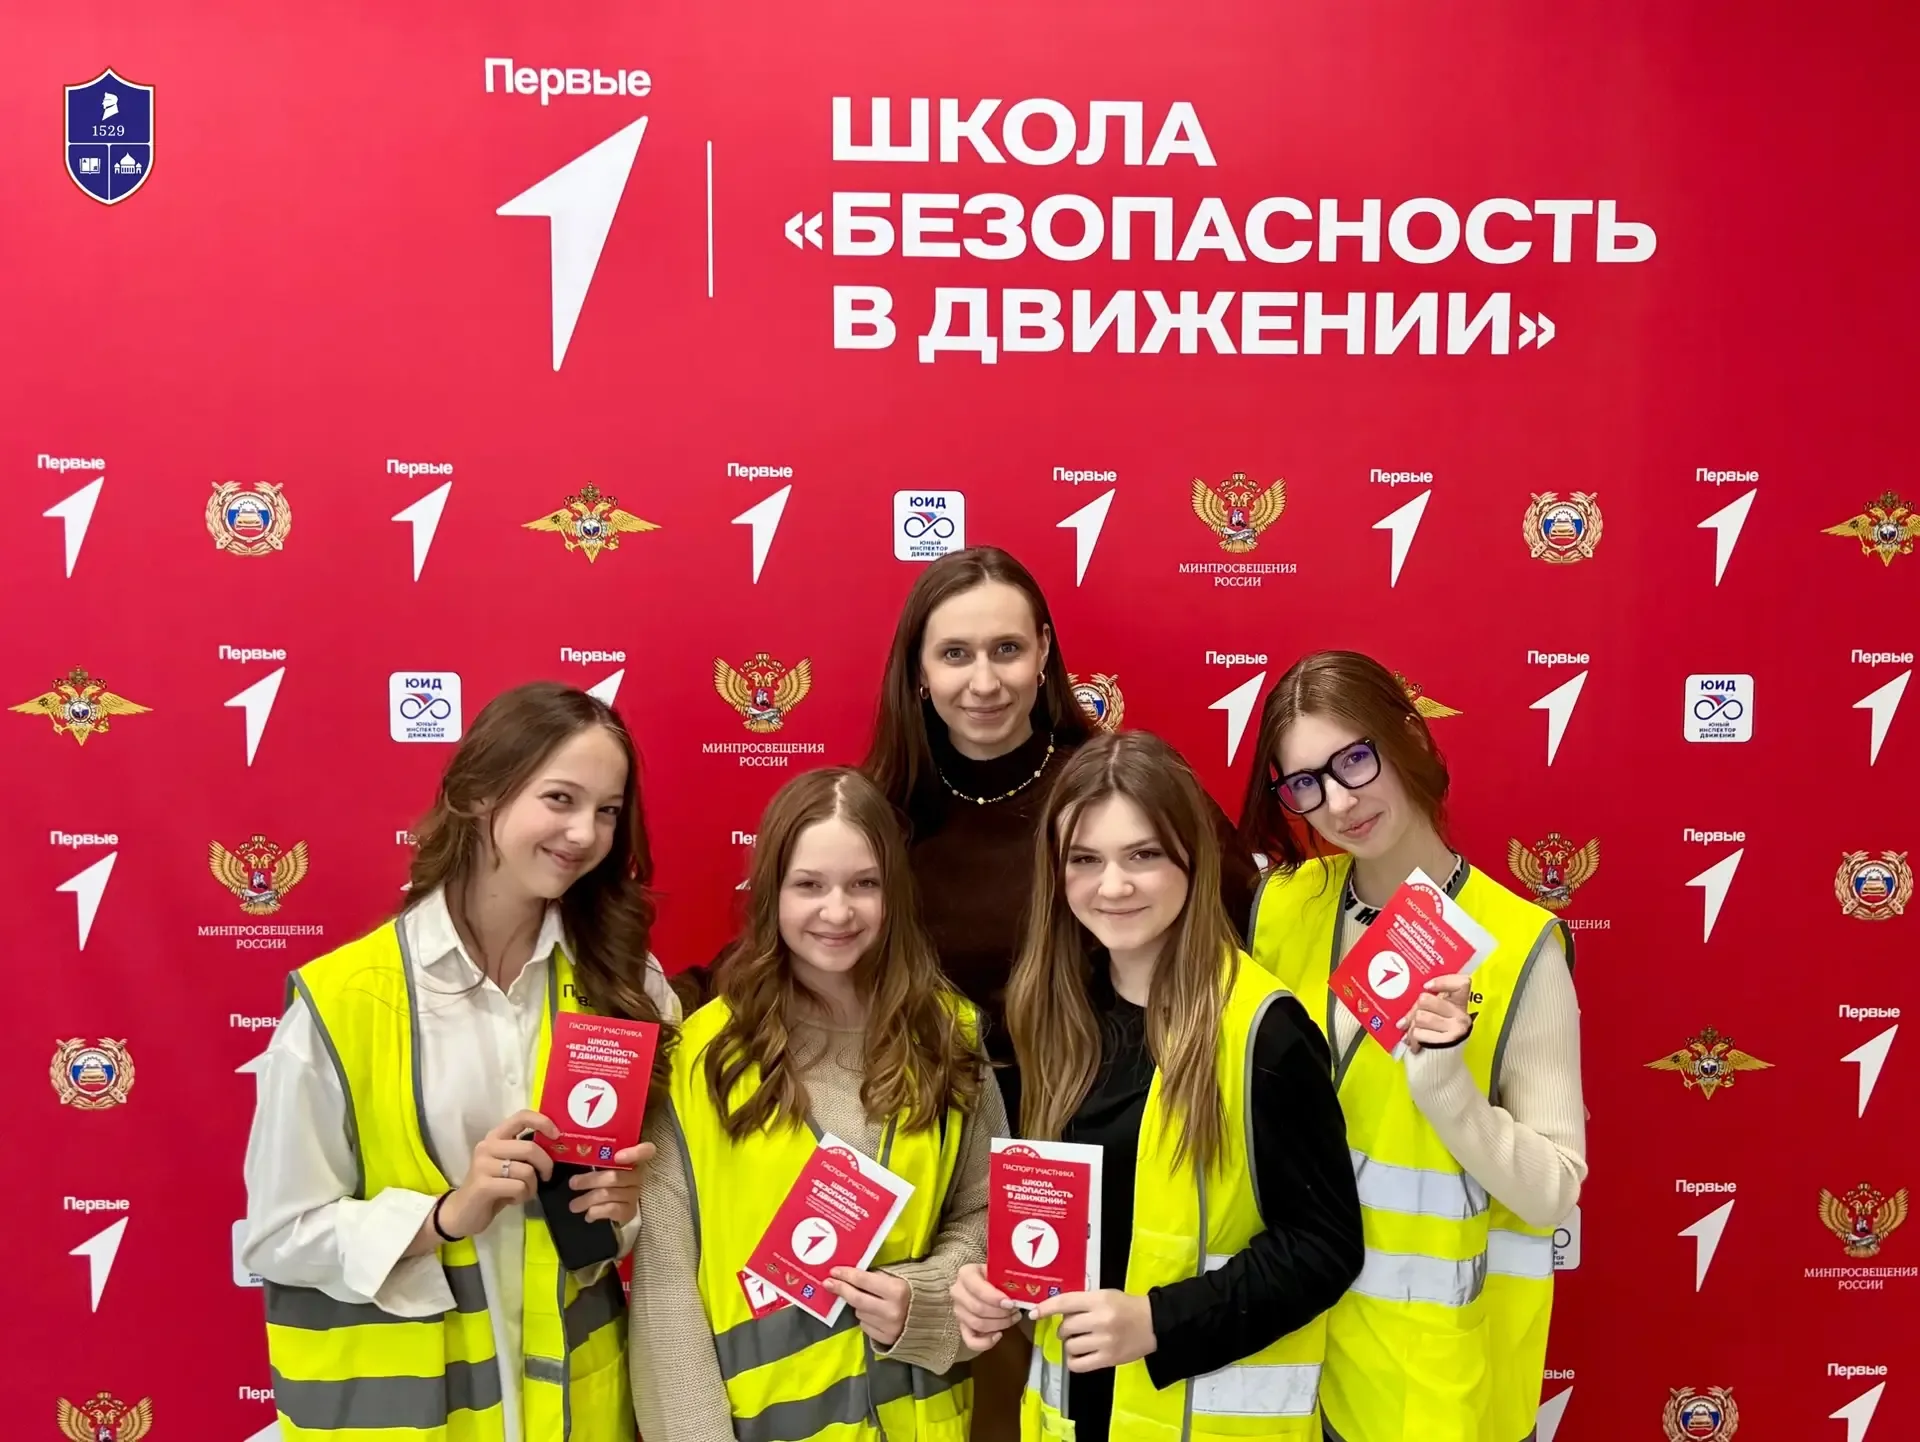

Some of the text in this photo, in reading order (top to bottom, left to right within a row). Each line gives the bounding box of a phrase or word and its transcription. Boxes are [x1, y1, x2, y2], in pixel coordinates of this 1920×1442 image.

[484, 58, 652, 106] Первые
[831, 97, 1218, 167] ШКОЛА
[784, 192, 1657, 265] «БЕЗОПАСНОСТЬ
[833, 286, 1556, 365] В ДВИЖЕНИИ»
[37, 454, 106, 472] Первые
[386, 459, 454, 477] Первые
[727, 463, 794, 481] Первые
[1053, 467, 1118, 483] Первые
[1370, 469, 1434, 485] Первые
[1695, 468, 1760, 485] Первые
[910, 496, 946, 509] ЮИД
[1178, 563, 1297, 575] МИНПРОСВЕЩЕНИЯ
[1214, 576, 1262, 587] РОССИИ
[218, 645, 287, 663] Первые
[560, 648, 627, 665] Первые
[1205, 651, 1268, 668] Первые
[1527, 651, 1590, 668] Первые
[1851, 650, 1914, 667] Первые
[405, 678, 442, 690] ЮИД
[1700, 680, 1736, 692] ЮИД
[702, 742, 825, 755] МИНПРОСВЕЩЕНИЯ
[739, 756, 788, 767] РОССИИ
[50, 831, 119, 849] Первые
[1683, 829, 1746, 846] Первые
[197, 925, 324, 937] МИНПРОСВЕЩЕНИЯ
[236, 938, 287, 950] РОССИИ
[1838, 1005, 1901, 1021] Первые
[229, 1014, 280, 1032] Первы
[569, 1021, 643, 1039] ПАСПОРТ УЧАСТНИКА
[587, 1037, 619, 1048] ШКОЛА
[1003, 1163, 1075, 1178] ПАСПОРТ УЧАСТНИКА
[1022, 1179, 1053, 1188] ШКОЛА
[1675, 1180, 1737, 1196] Первые
[63, 1197, 130, 1214] Первые
[1804, 1266, 1918, 1278] МИНПРОСВЕЩЕНИЯ
[1838, 1279, 1884, 1290] РОССИИ
[1544, 1369, 1575, 1380] вые
[1827, 1363, 1888, 1380] Первые
[239, 1385, 275, 1403] Пер
